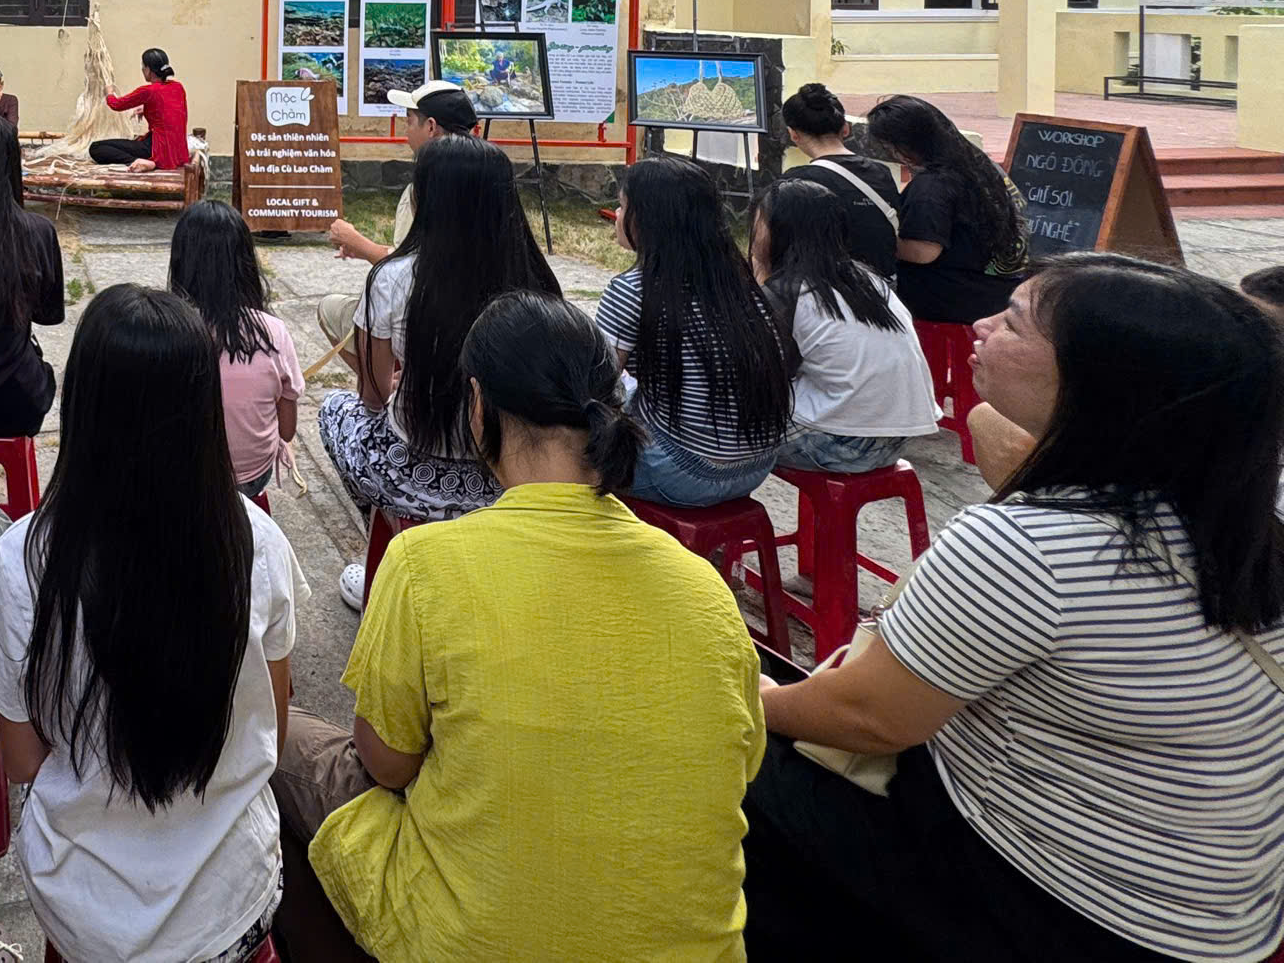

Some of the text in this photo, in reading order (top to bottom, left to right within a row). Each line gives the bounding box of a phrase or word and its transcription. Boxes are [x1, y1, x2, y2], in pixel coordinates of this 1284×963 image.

[283, 133, 304, 141] thiên
[306, 133, 329, 141] nhiên
[1037, 130, 1105, 148] WORKSHOP
[293, 165, 308, 173] Lao
[266, 198, 319, 206] LOCAL GIFT &
[248, 209, 338, 217] COMMUNITY TOURISM
